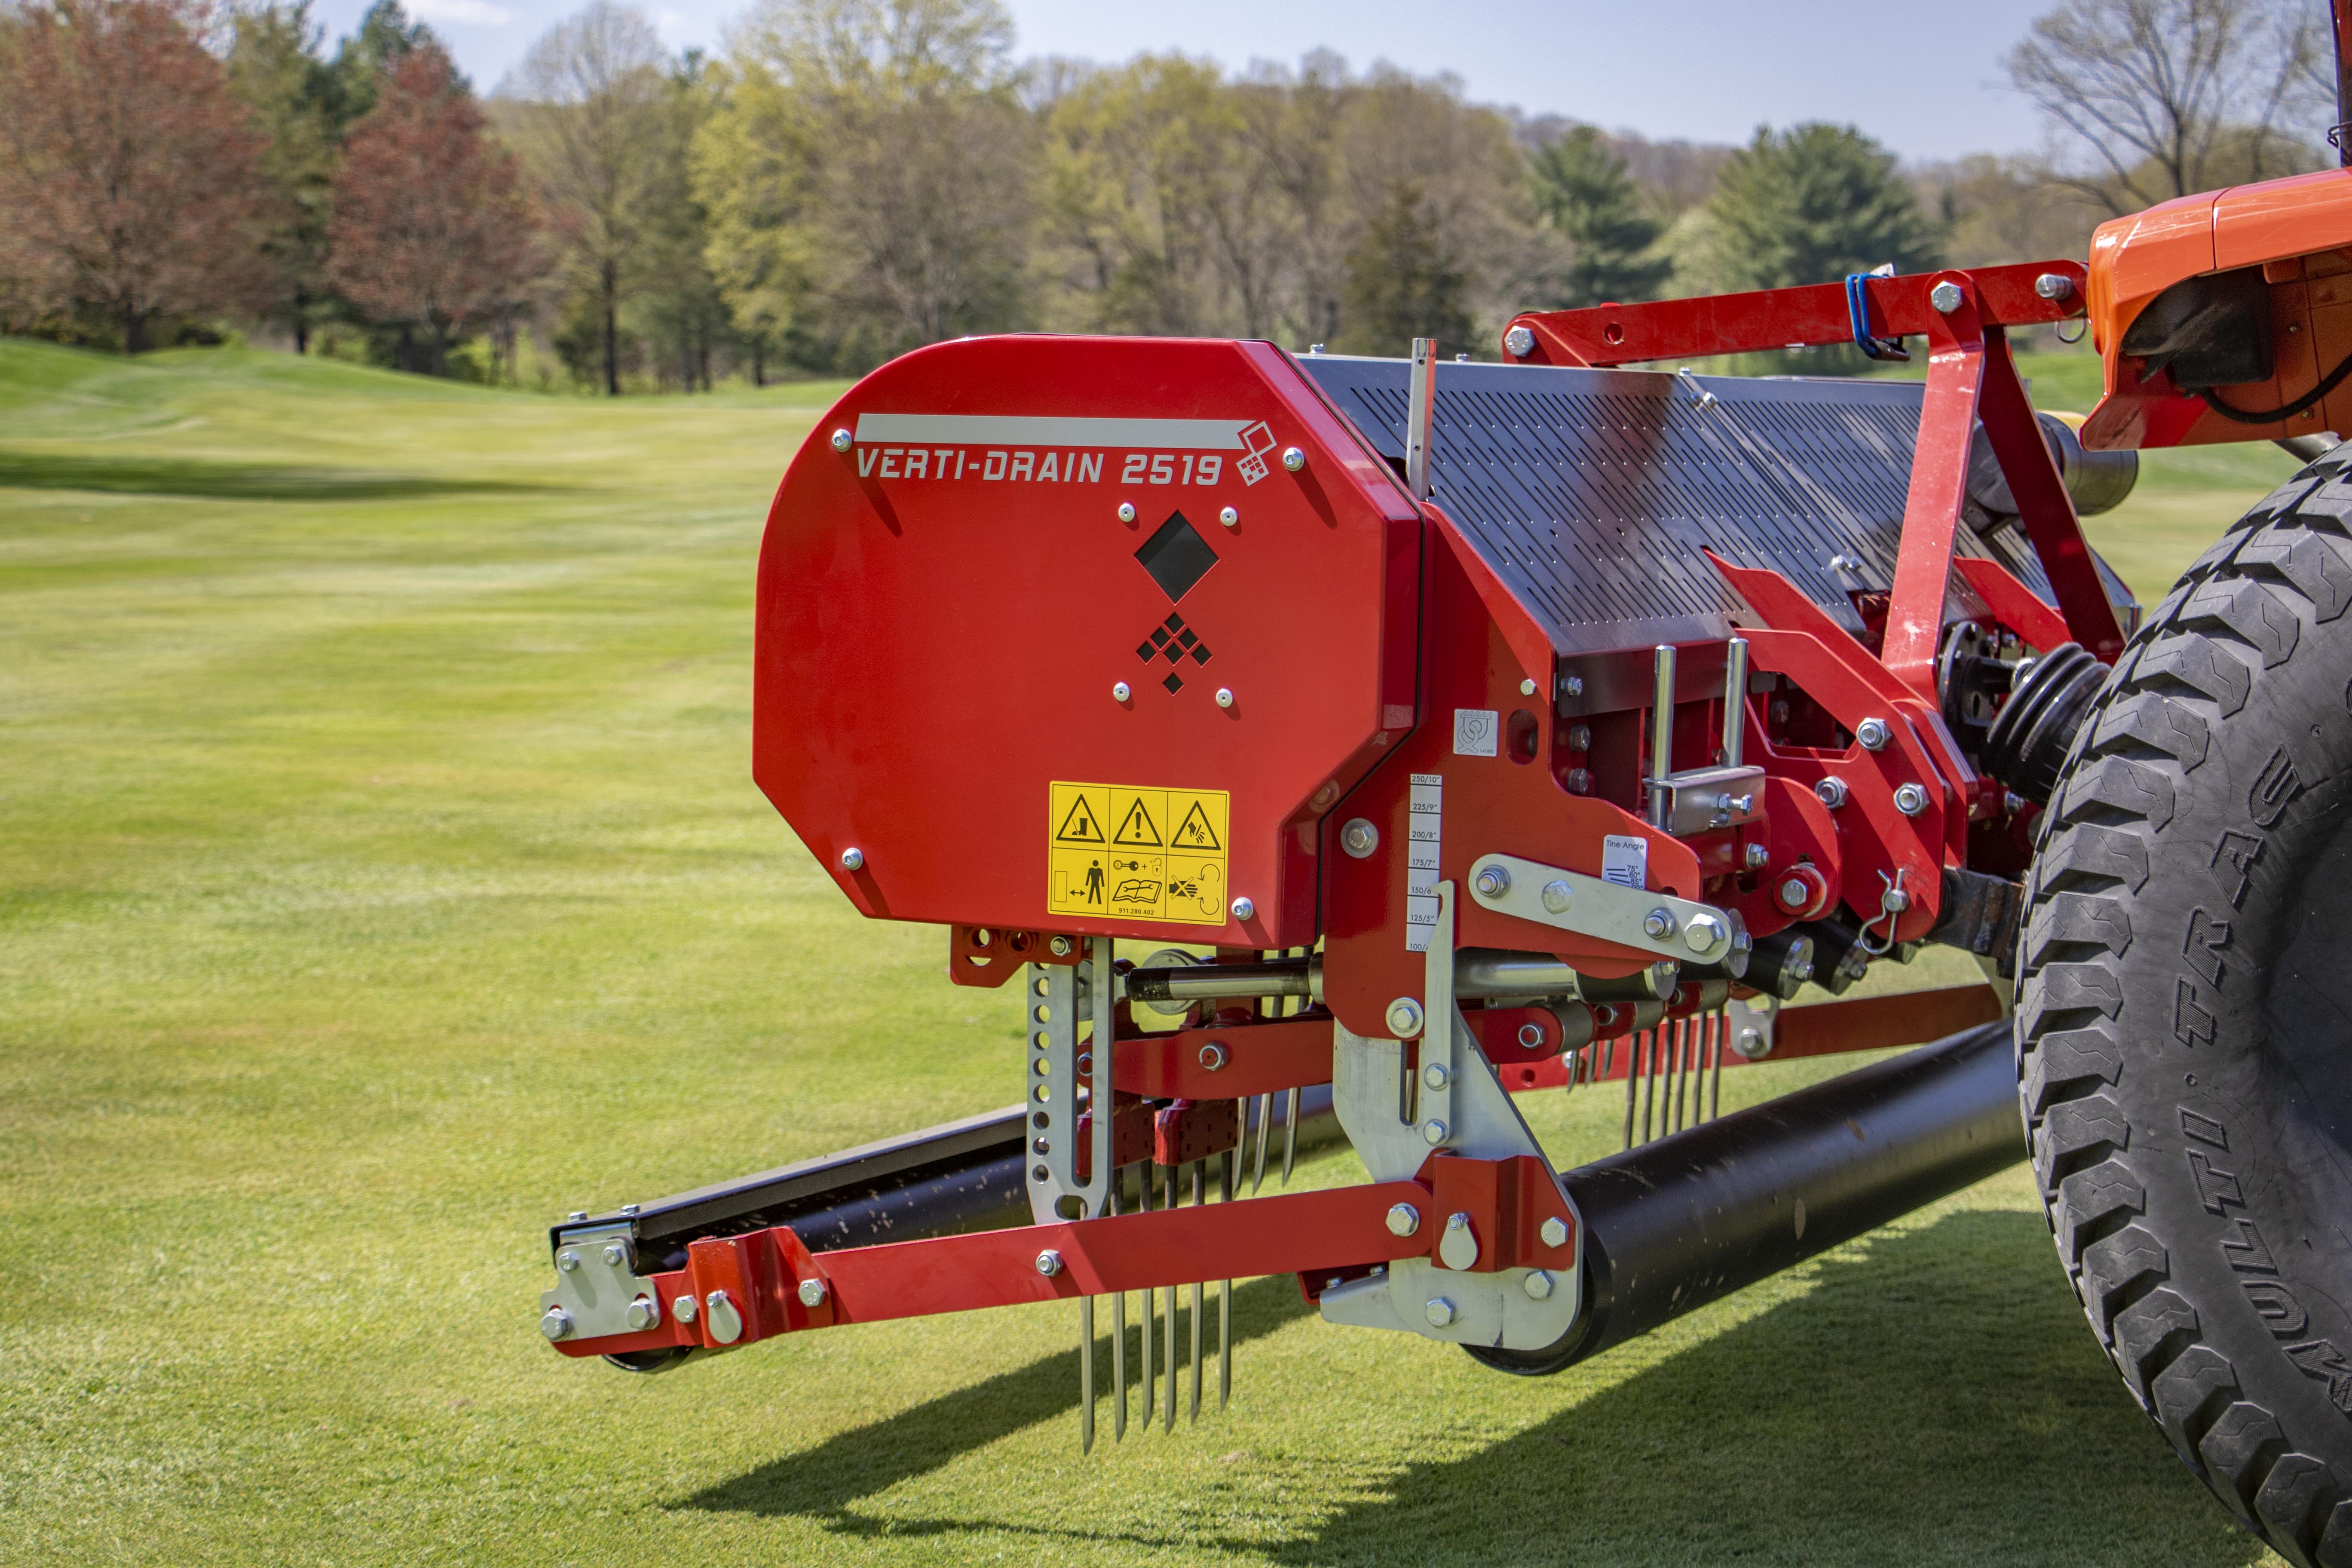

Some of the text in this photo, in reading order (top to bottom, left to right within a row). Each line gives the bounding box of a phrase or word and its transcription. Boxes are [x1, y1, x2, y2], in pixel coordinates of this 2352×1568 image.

[857, 448, 1222, 486] VERTI-DRAIN 2519
[1623, 842, 1645, 851] Angle
[1410, 943, 1428, 952] 100/
